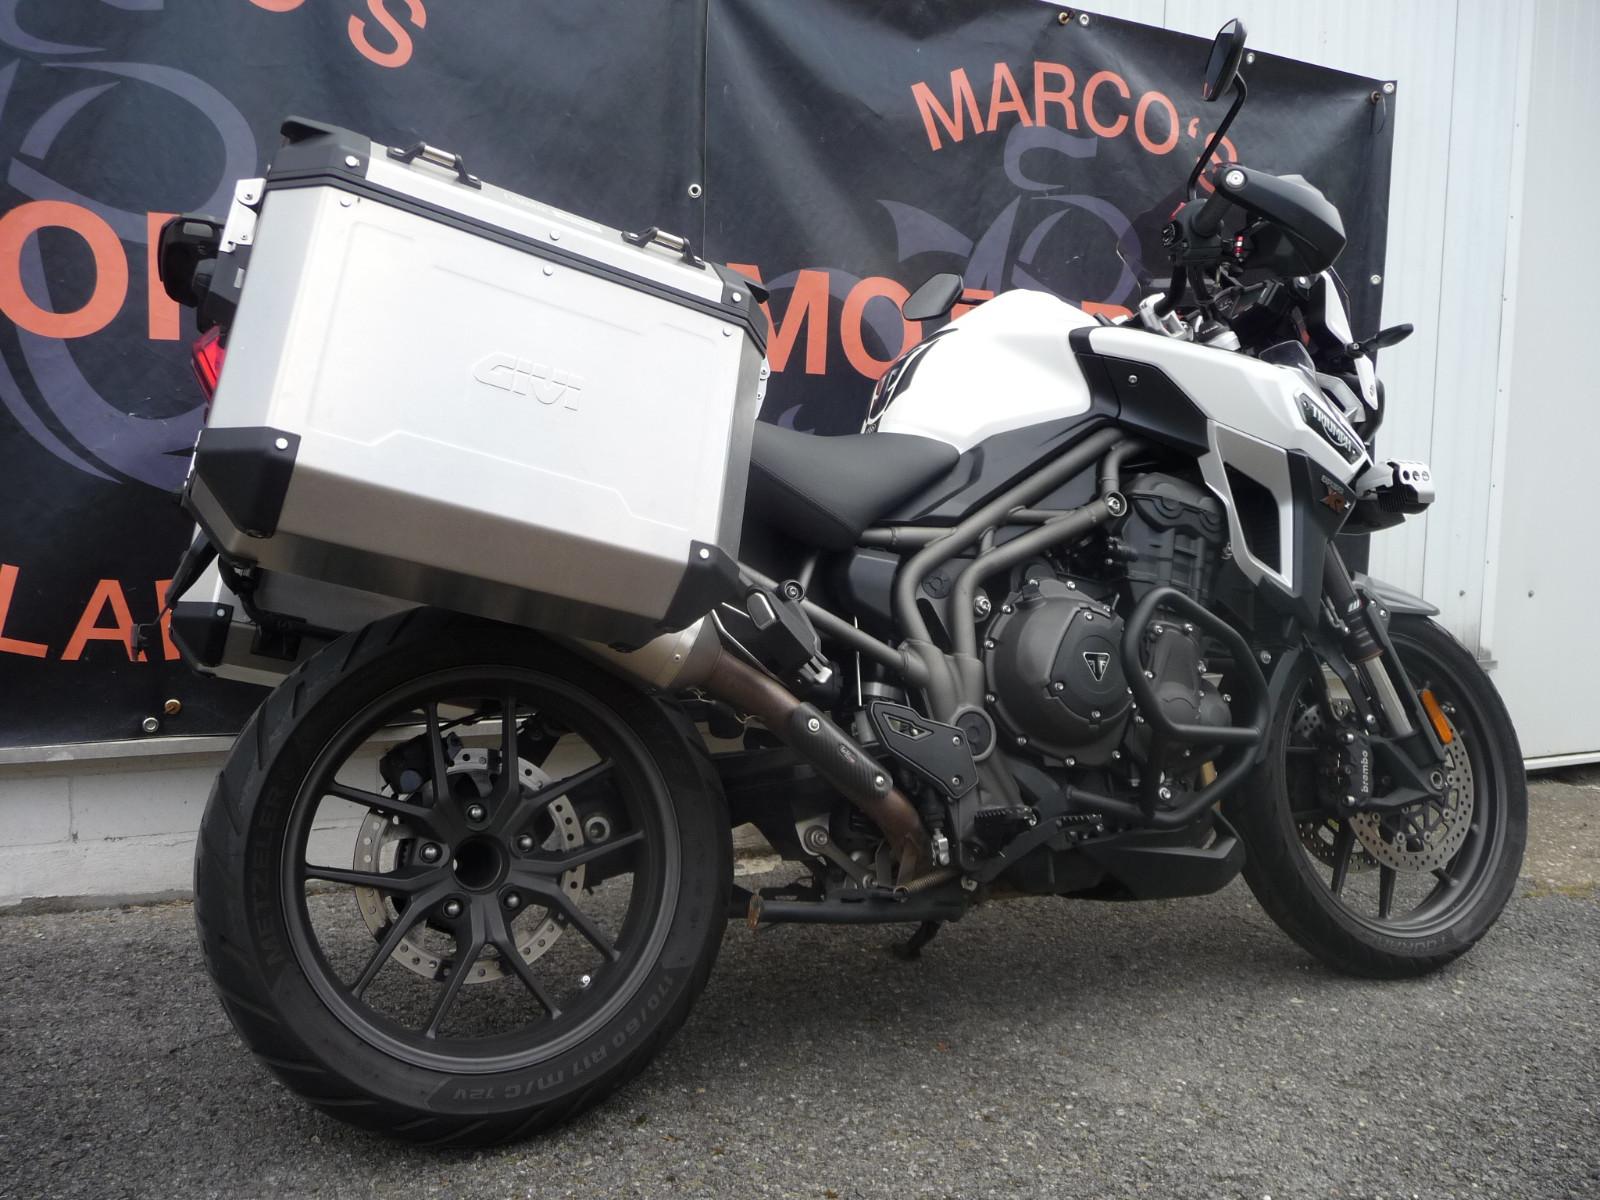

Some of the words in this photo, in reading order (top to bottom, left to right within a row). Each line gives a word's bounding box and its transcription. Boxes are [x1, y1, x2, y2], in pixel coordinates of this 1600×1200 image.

[472, 351, 584, 412] GIVI
[1310, 403, 1353, 453] TRIUMPH
[1361, 750, 1369, 793] brembo
[251, 787, 287, 967] METZELER
[610, 974, 674, 1049] 170/60
[571, 1044, 608, 1072] R17
[453, 1086, 495, 1100] 72V
